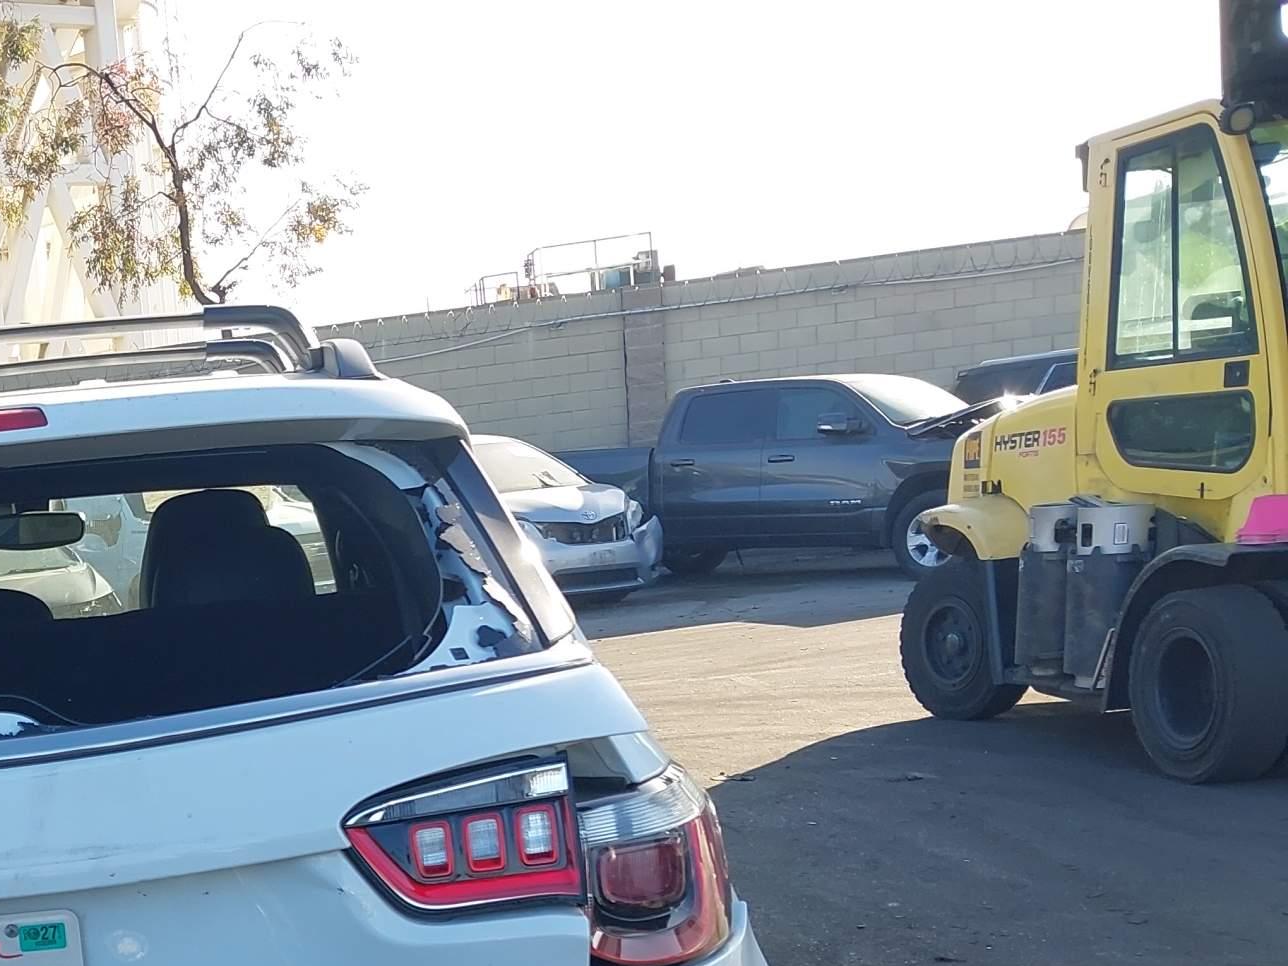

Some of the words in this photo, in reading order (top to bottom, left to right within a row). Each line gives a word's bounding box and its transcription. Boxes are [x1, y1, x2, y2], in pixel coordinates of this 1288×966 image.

[994, 431, 1041, 452] HYSTER
[1043, 427, 1067, 447] 155
[40, 926, 57, 940] 27
